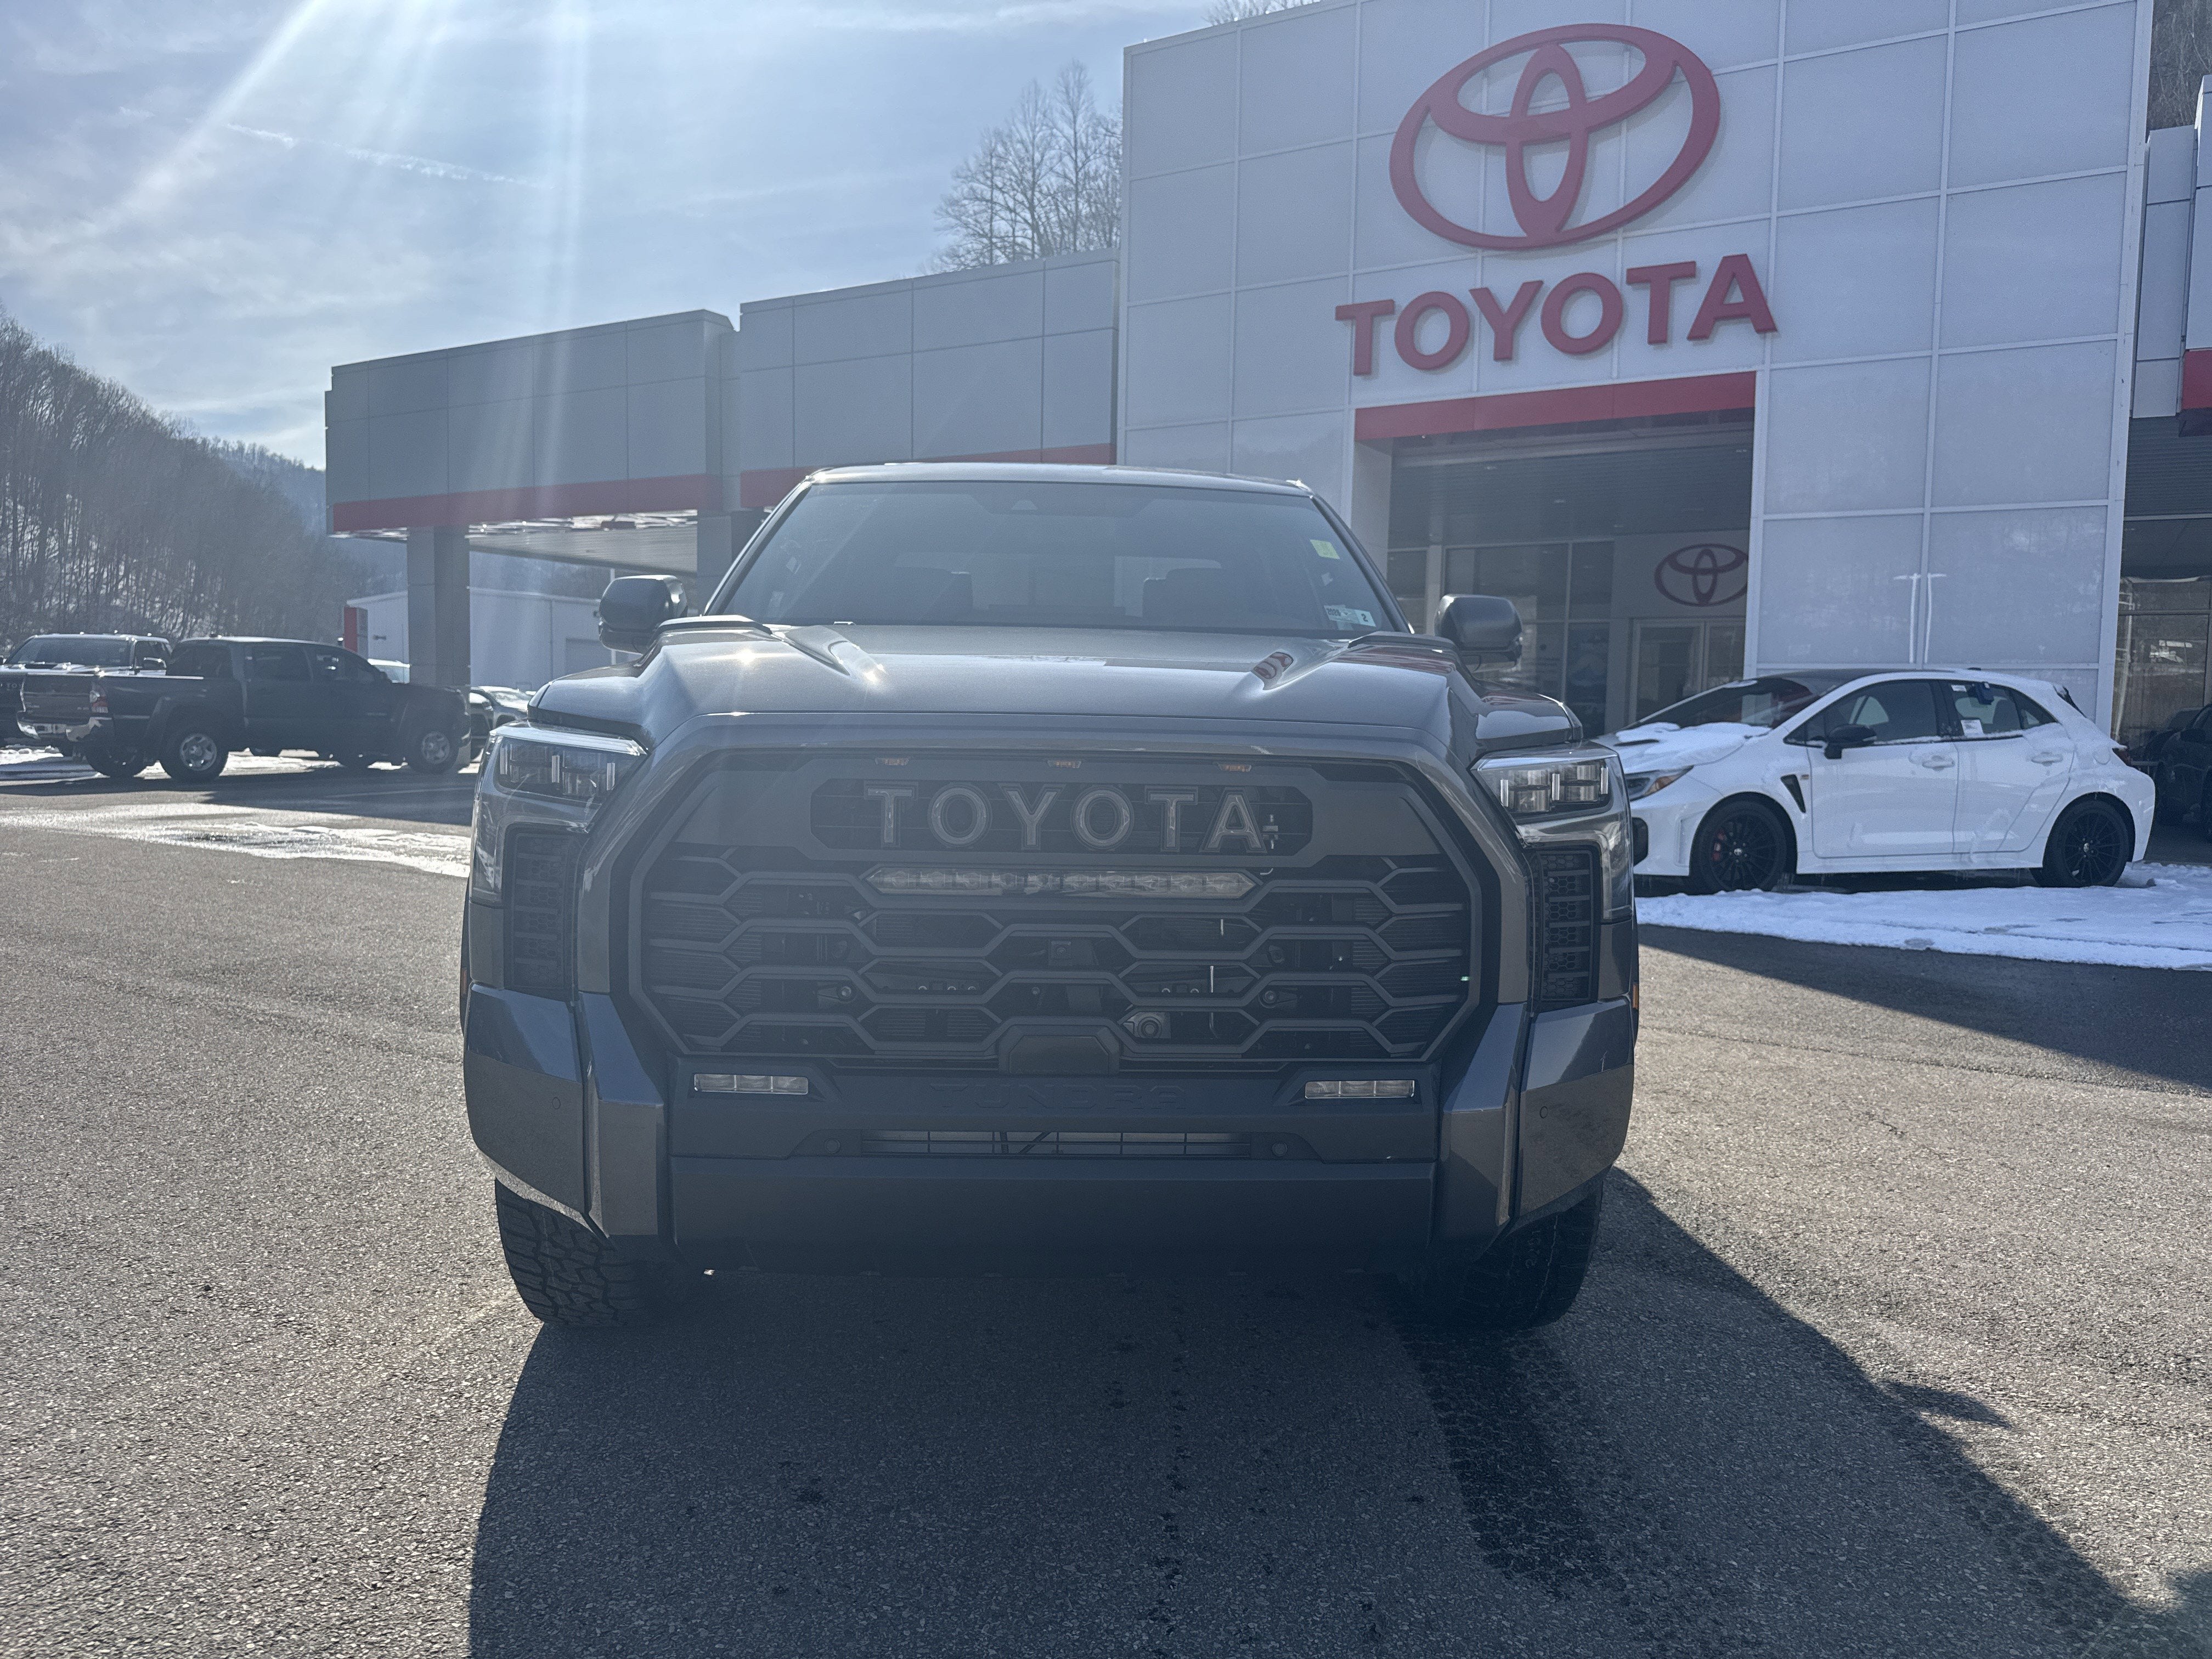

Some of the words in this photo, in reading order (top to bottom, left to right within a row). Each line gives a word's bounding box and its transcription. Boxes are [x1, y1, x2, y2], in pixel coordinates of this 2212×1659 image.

[1335, 253, 1778, 376] TOYOTA
[865, 783, 1265, 851] TOYOTA
[930, 1084, 1187, 1110] TUNDRA
